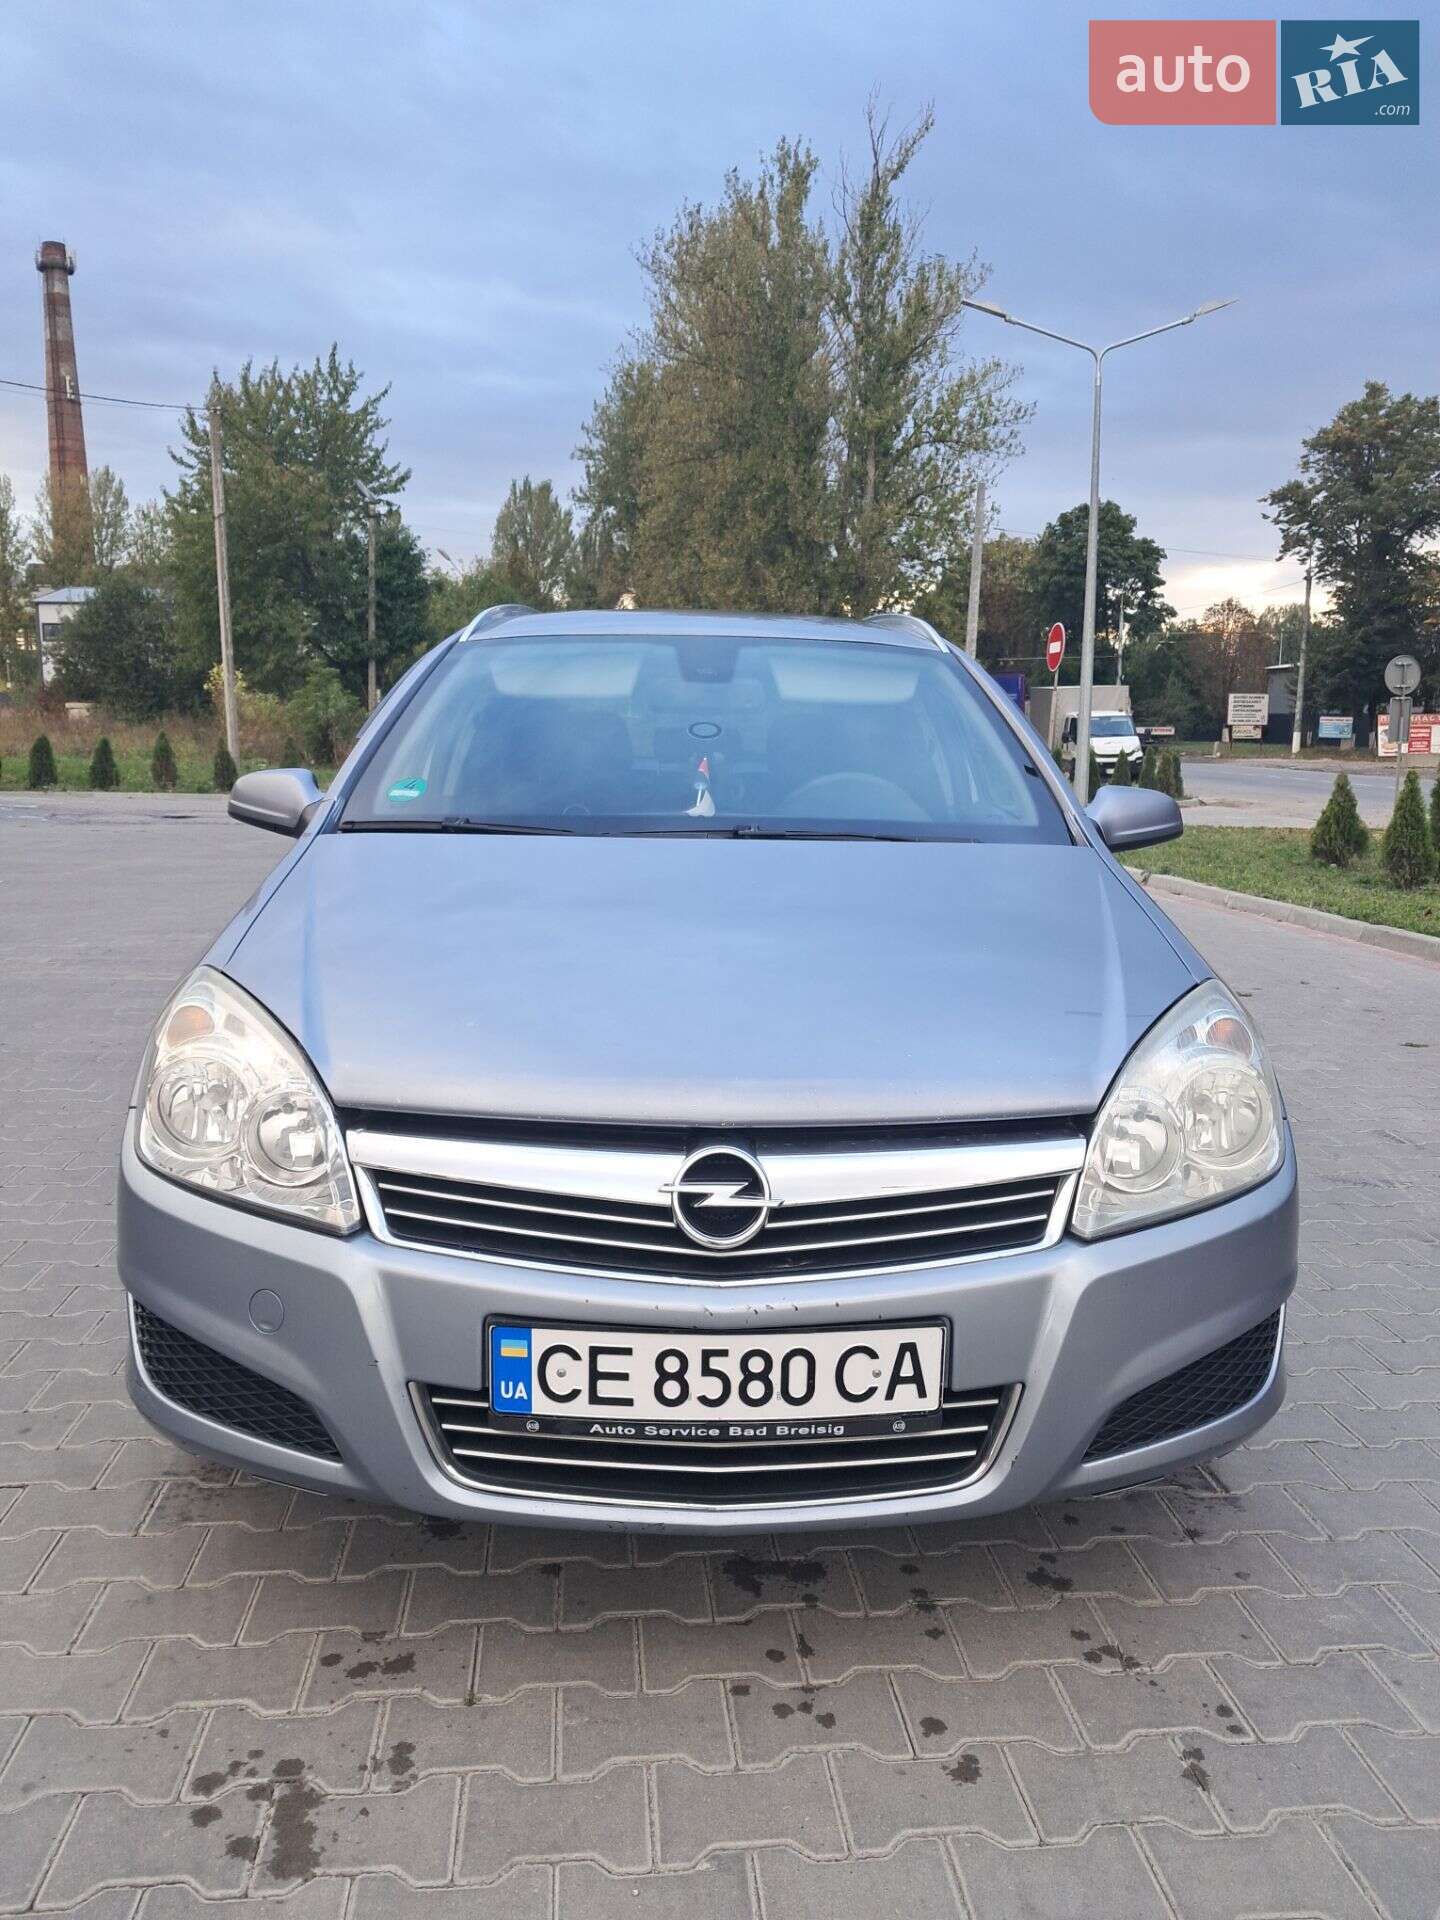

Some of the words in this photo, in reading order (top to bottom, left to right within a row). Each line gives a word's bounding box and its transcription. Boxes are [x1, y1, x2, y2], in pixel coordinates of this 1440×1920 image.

[538, 1344, 634, 1407] CE
[653, 1348, 816, 1408] 8580
[835, 1341, 928, 1403] CA
[500, 1381, 528, 1400] UA
[589, 1423, 636, 1435] Auto
[644, 1426, 720, 1436] Service
[729, 1426, 767, 1436] Bad
